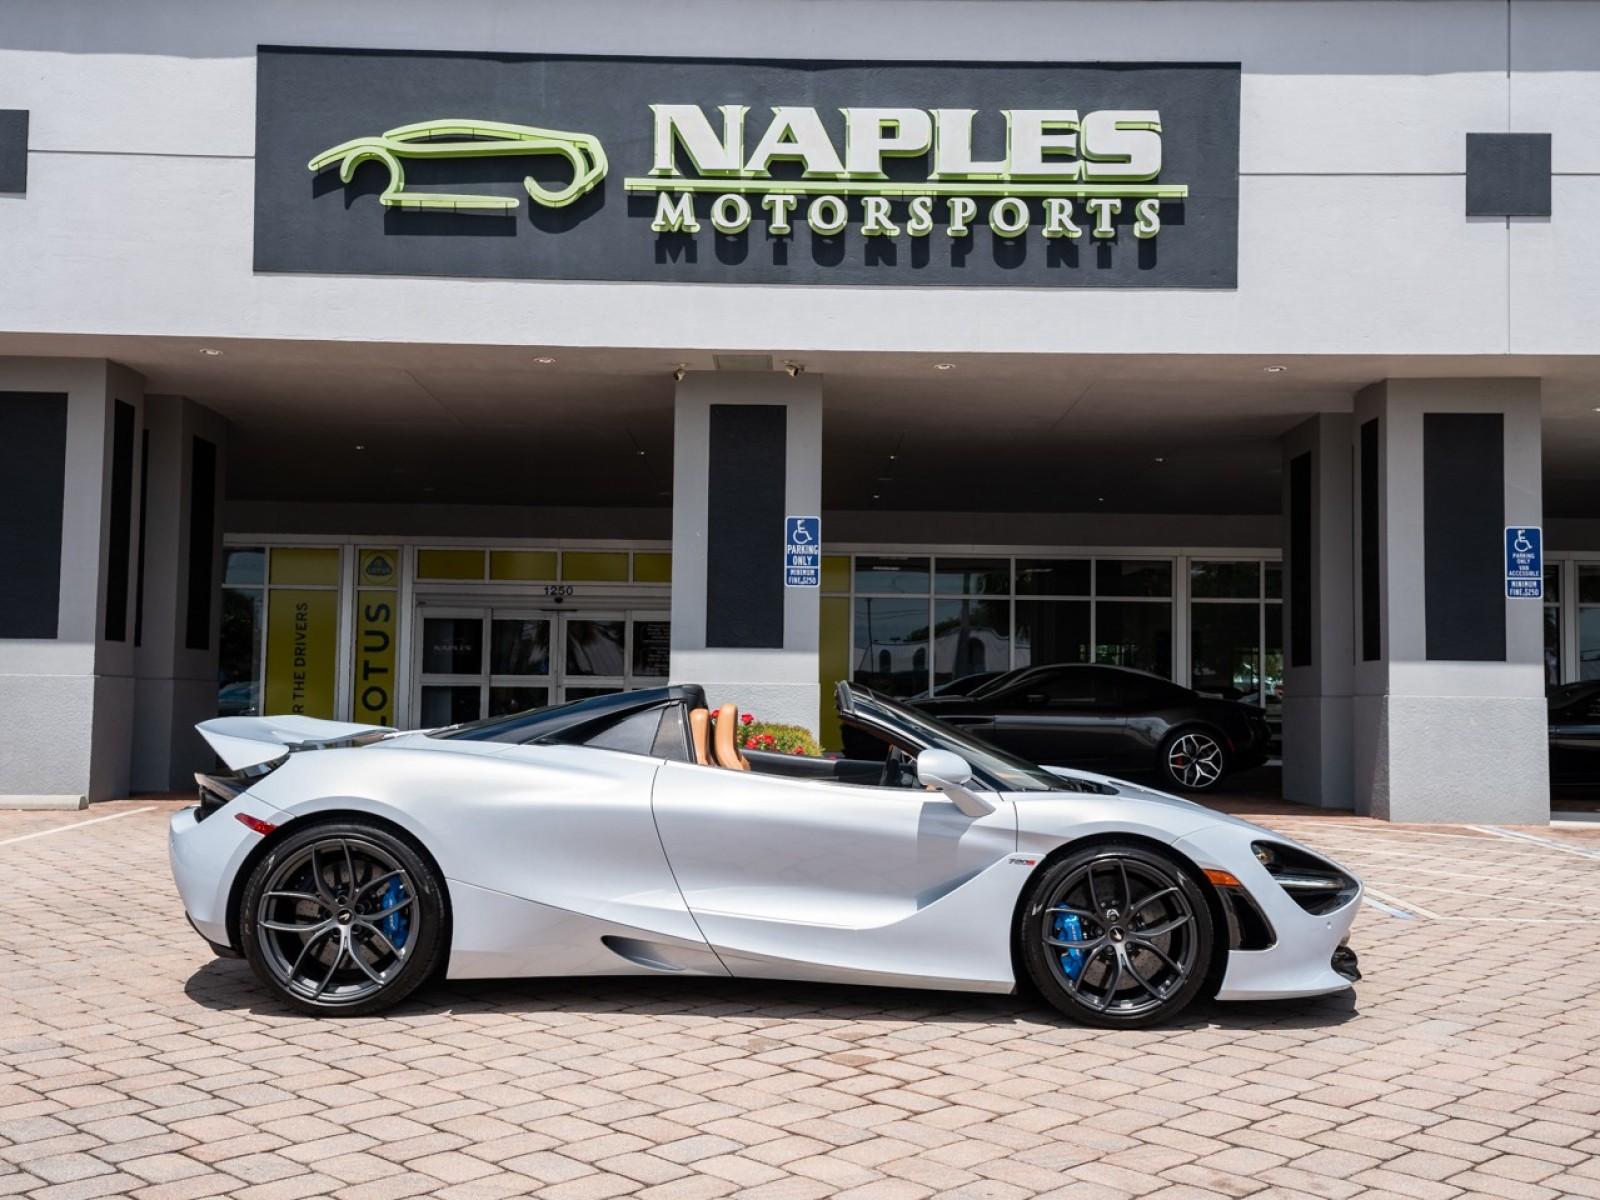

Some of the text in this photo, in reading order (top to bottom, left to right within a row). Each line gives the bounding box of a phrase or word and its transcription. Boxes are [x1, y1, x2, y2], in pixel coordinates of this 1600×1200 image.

[649, 103, 1163, 181] NAPLES
[650, 191, 1161, 239] MOTORSPORTS
[787, 544, 818, 555] PARKING
[792, 555, 813, 566] ONLY
[544, 584, 575, 596] 1250
[294, 602, 308, 667] DRIVERS
[292, 671, 306, 701] THE
